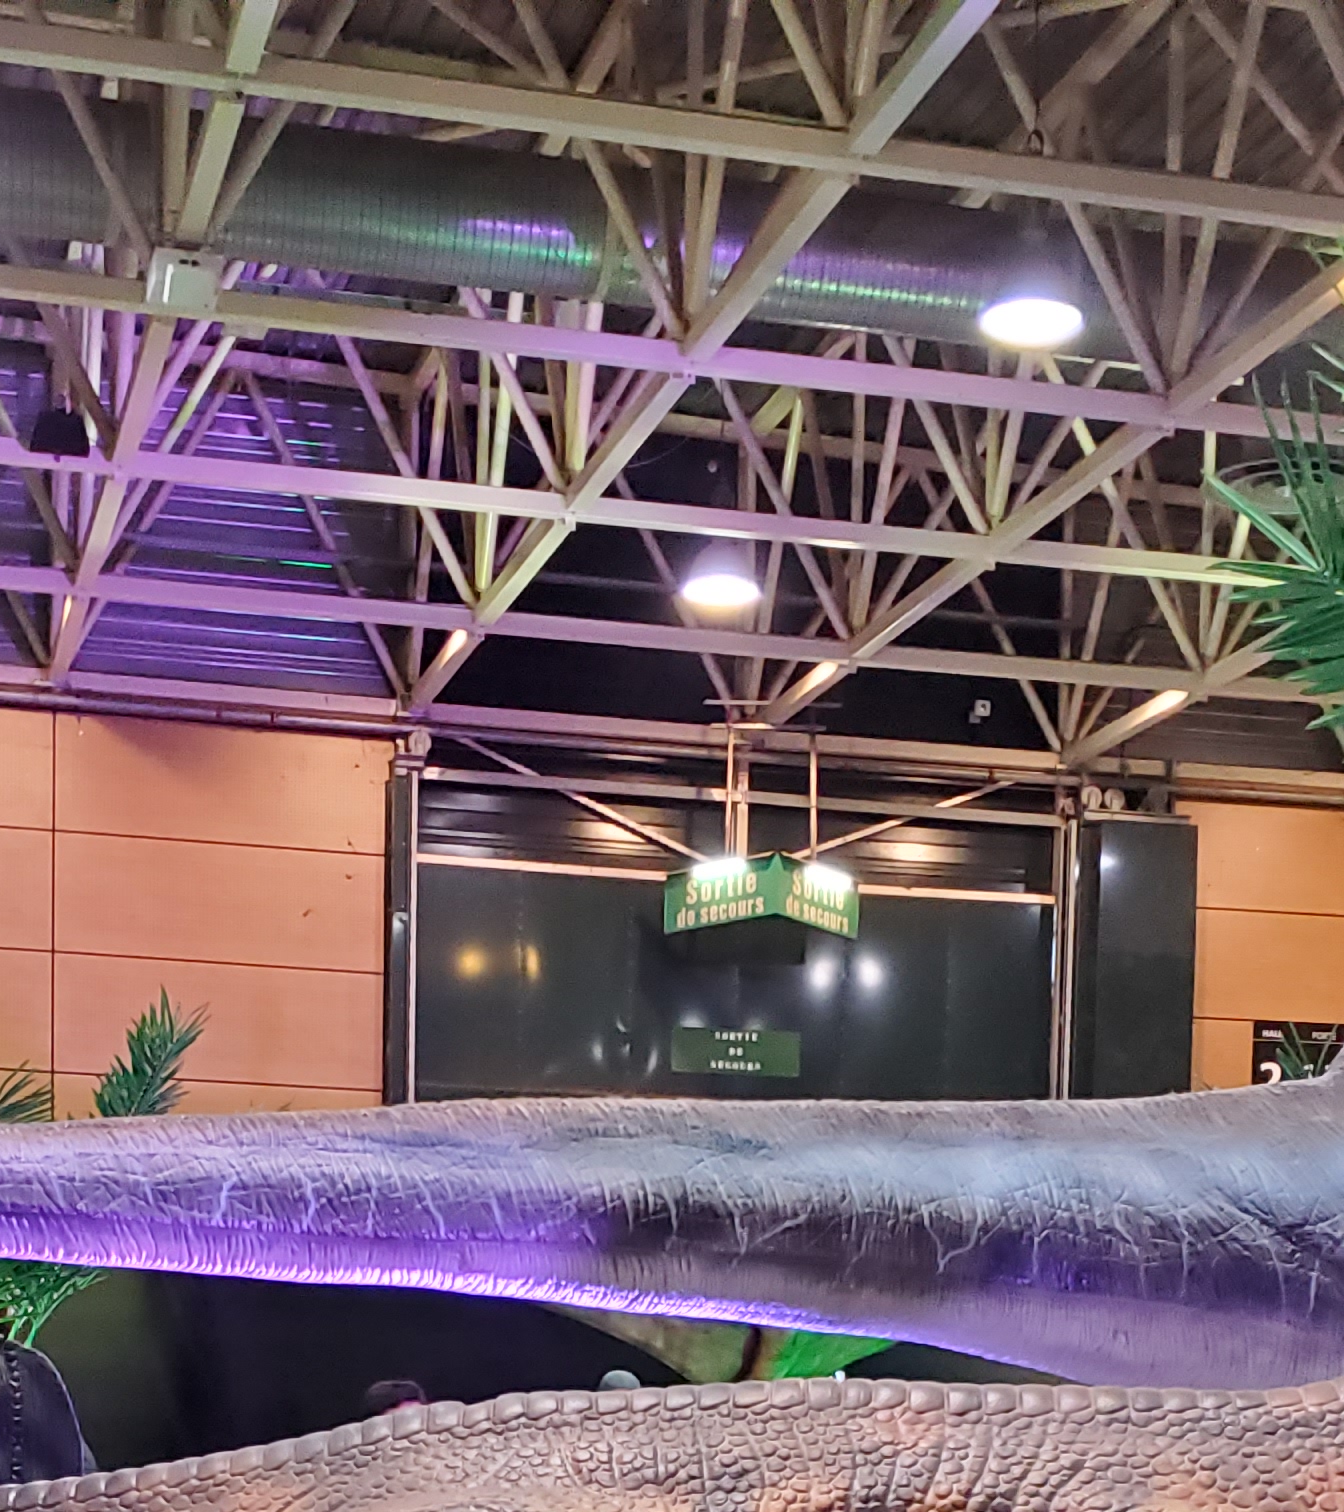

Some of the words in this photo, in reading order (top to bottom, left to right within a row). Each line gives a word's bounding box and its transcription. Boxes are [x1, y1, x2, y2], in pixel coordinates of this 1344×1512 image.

[686, 871, 757, 905] Sortie
[700, 896, 765, 925] secours
[786, 894, 800, 918] de
[803, 903, 849, 934] secours
